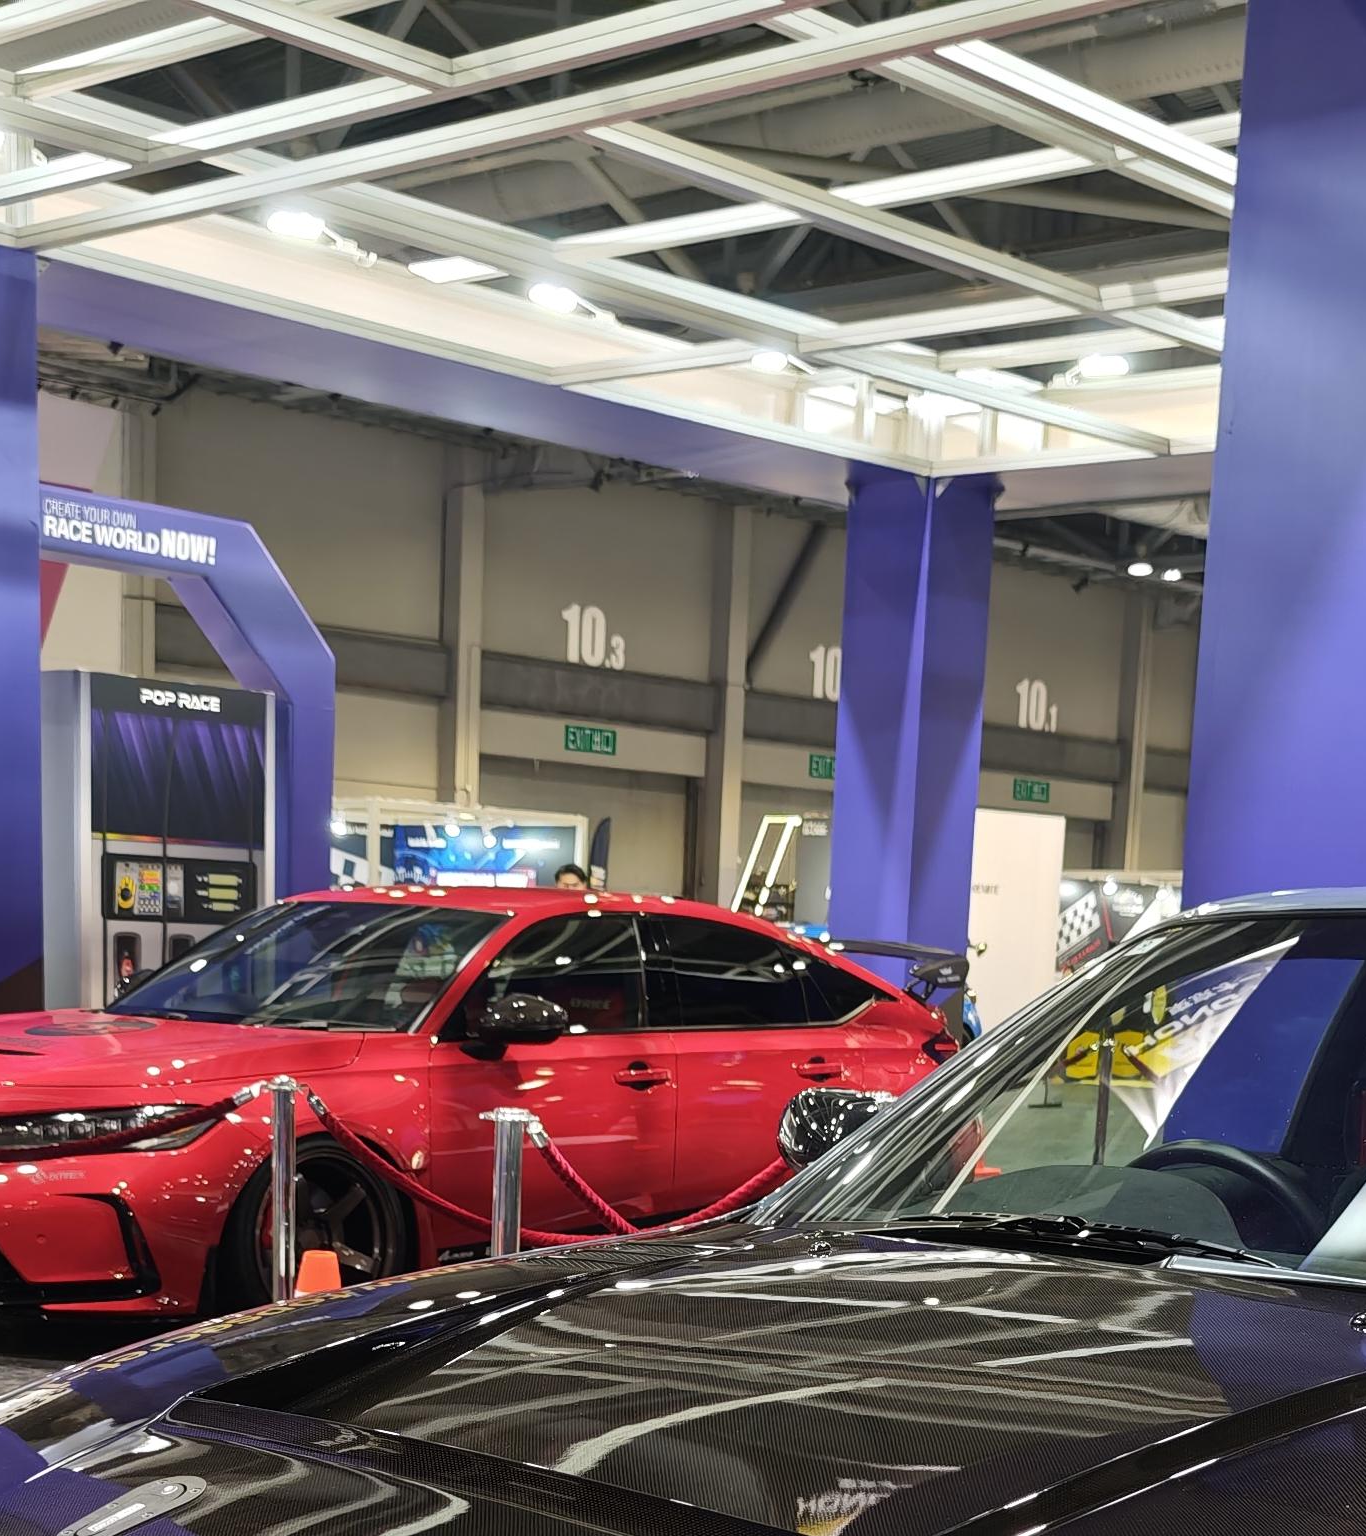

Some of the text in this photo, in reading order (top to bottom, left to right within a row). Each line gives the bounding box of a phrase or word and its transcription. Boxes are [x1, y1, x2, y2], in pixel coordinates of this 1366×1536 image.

[43, 515, 217, 566] RACE WORLD NOW!
[561, 602, 626, 671] 10.3
[139, 687, 221, 713] POP RACE
[1016, 678, 1059, 733] 10.1
